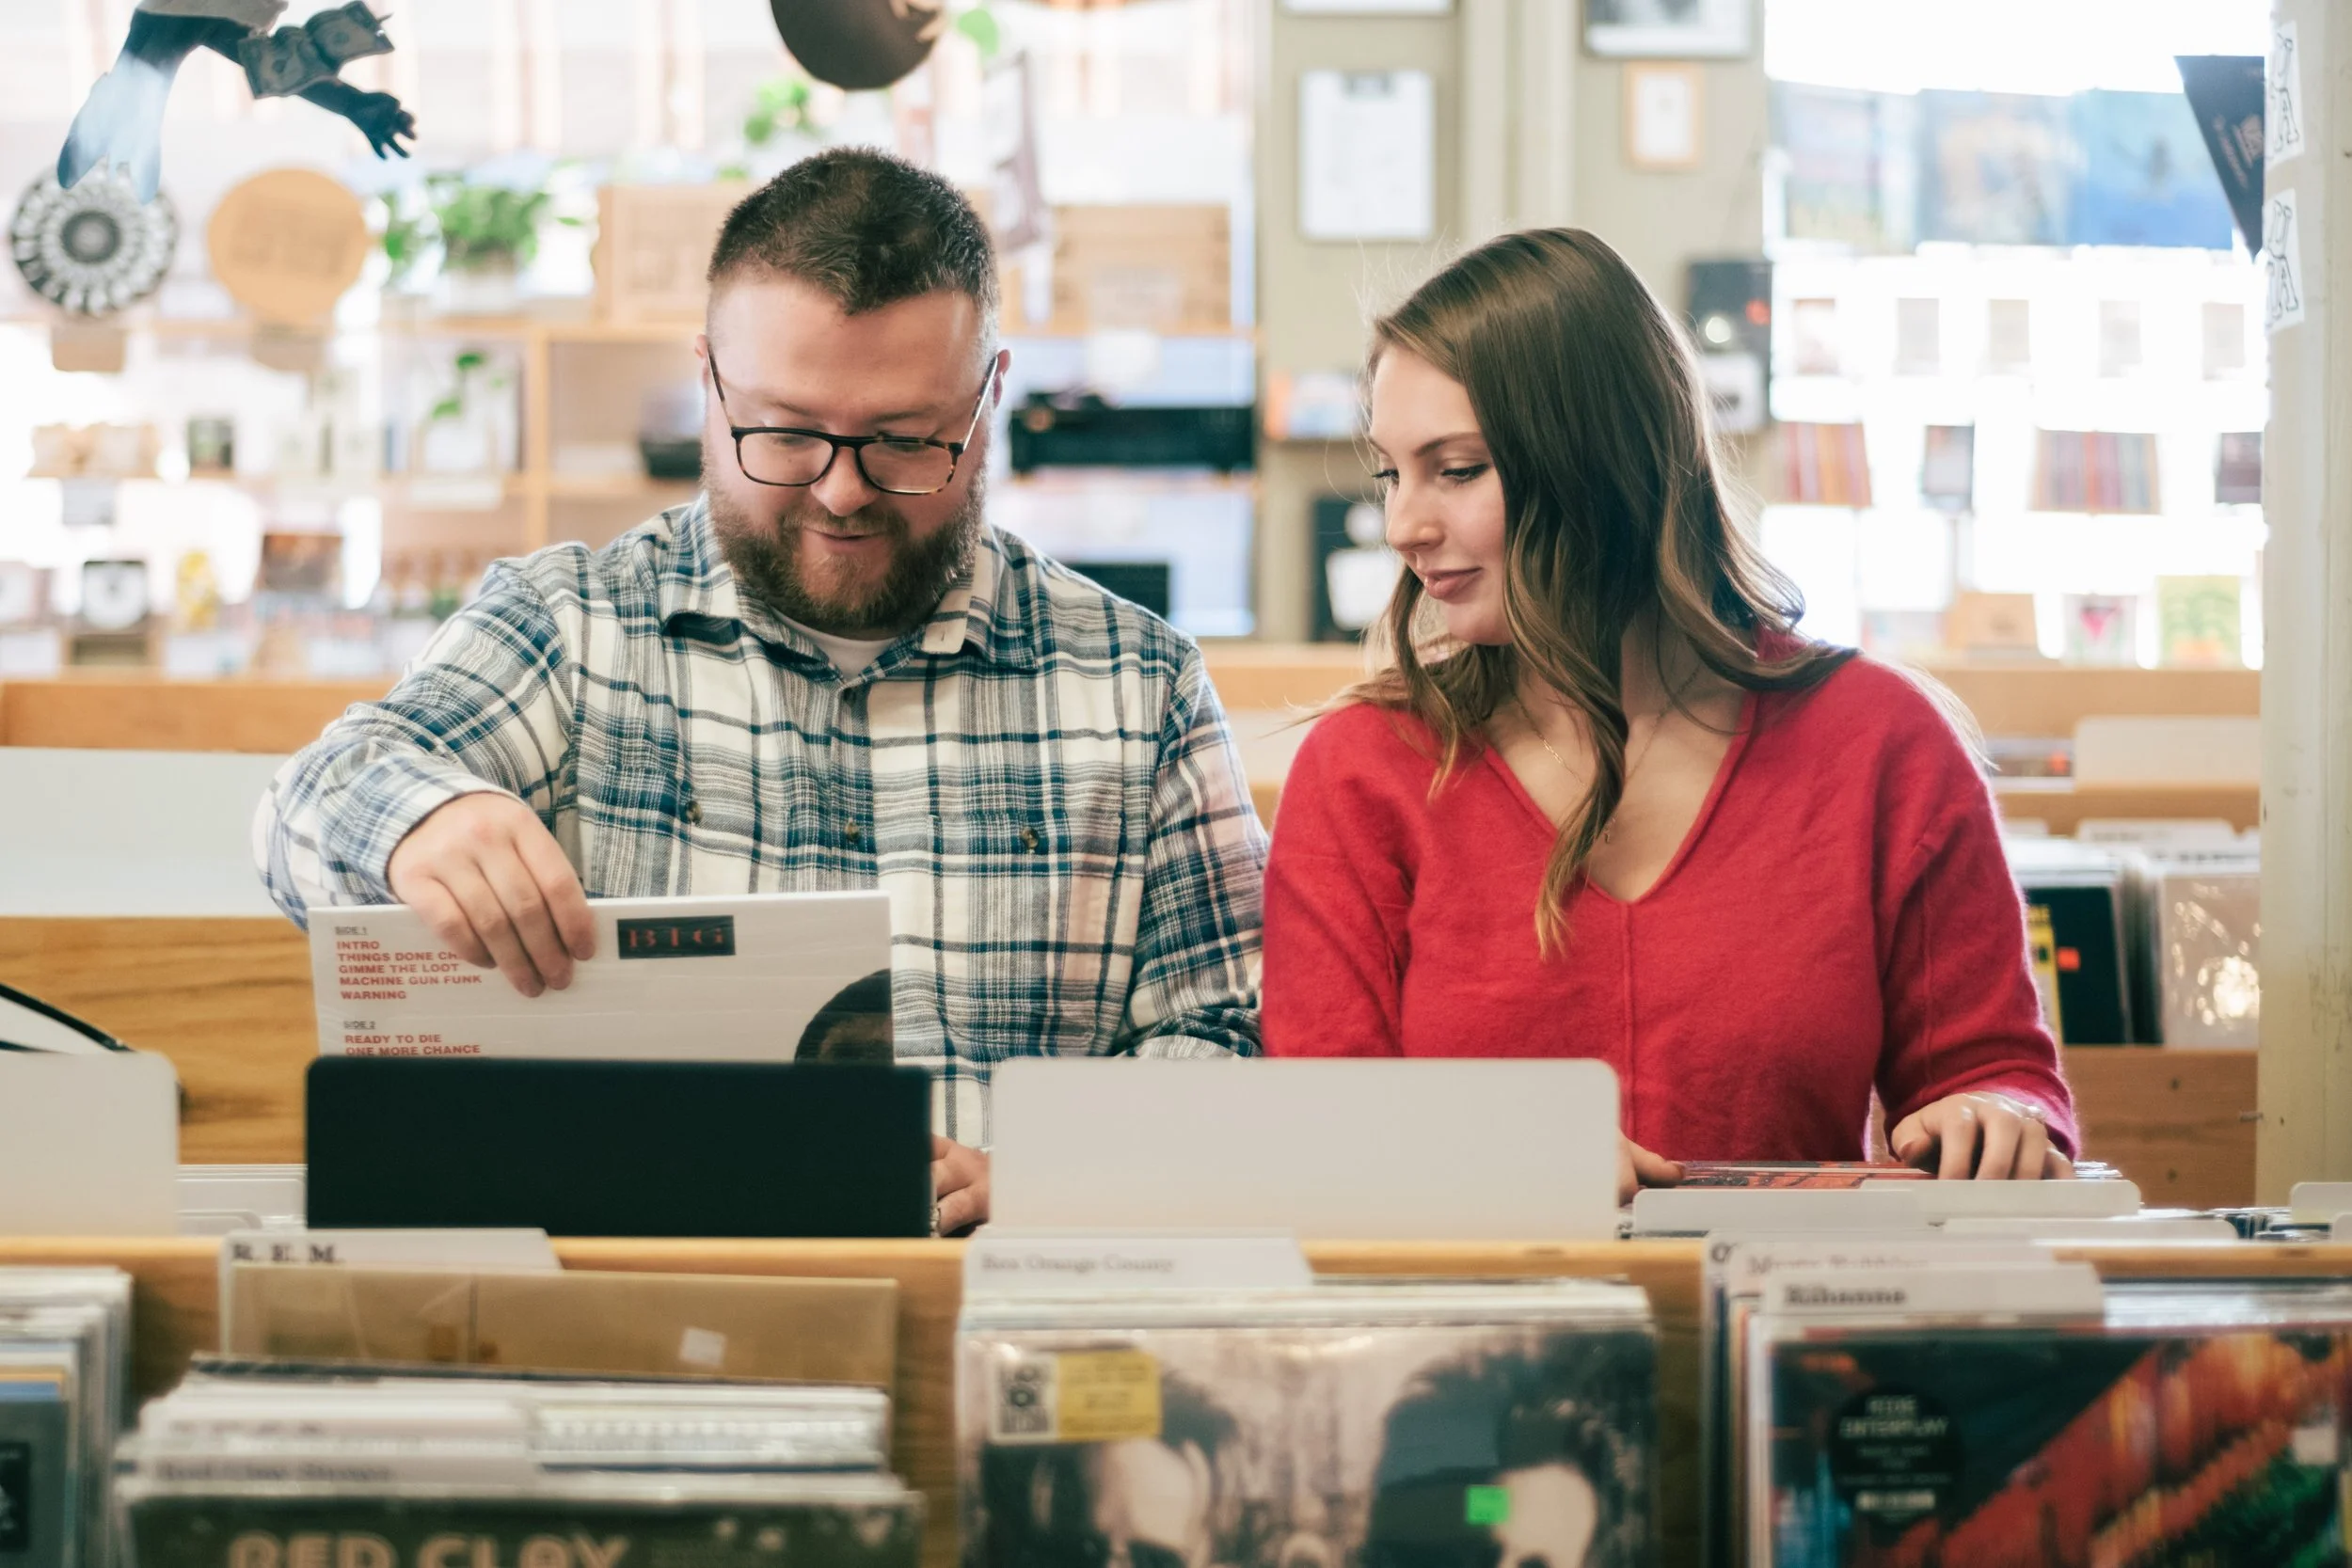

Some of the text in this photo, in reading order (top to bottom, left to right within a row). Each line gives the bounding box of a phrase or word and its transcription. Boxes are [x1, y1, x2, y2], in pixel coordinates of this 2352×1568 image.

[337, 941, 381, 950] INTRO
[338, 952, 391, 962] THINGS
[394, 951, 434, 961] DONE
[339, 962, 460, 974] GIMME THE LOOT
[339, 974, 483, 986] MACHINE GUN FUNK
[341, 990, 407, 1000] WARNING
[344, 1034, 442, 1044] READY TO DIE
[345, 1044, 482, 1056] ONE MORE CHANCE
